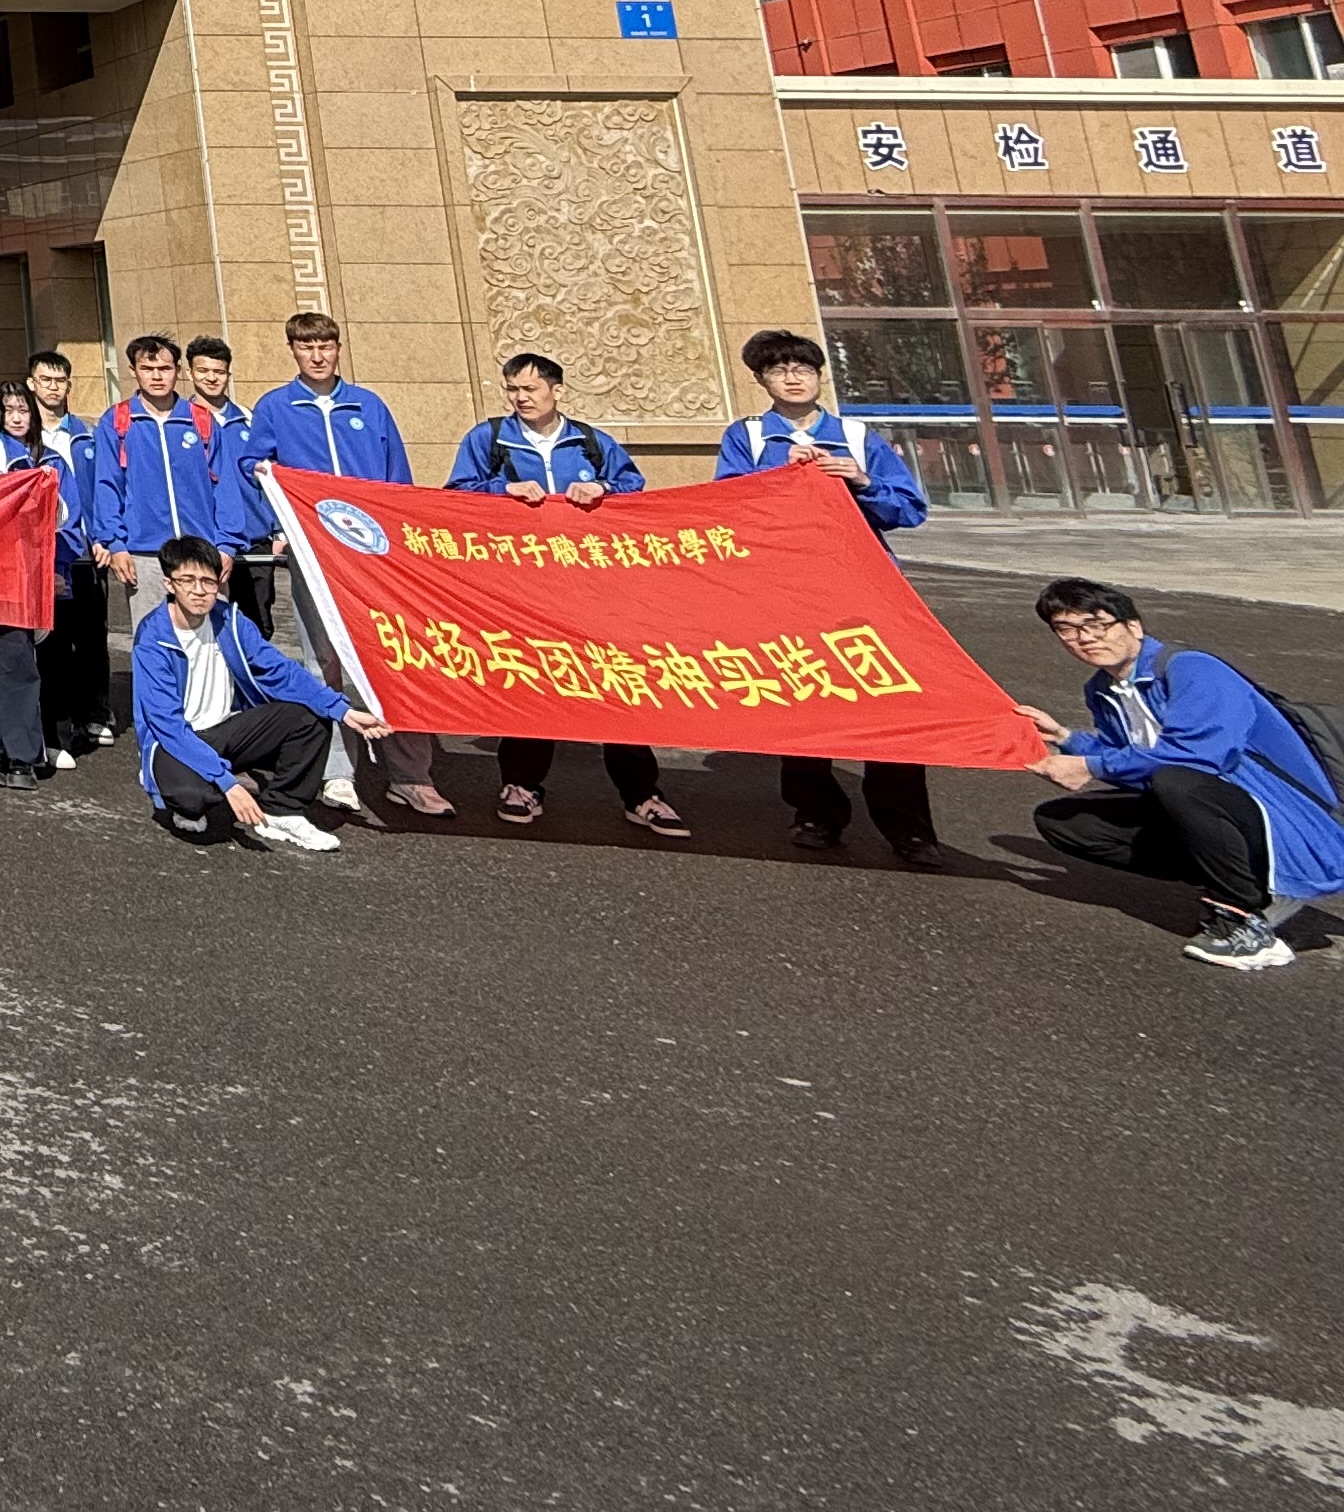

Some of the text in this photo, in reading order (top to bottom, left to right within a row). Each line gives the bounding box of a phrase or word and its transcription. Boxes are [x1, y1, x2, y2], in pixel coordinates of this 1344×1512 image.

[641, 13, 652, 28] 1
[860, 123, 1326, 174] 安检通道
[369, 608, 923, 710] 弘扬兵团精神实践团
